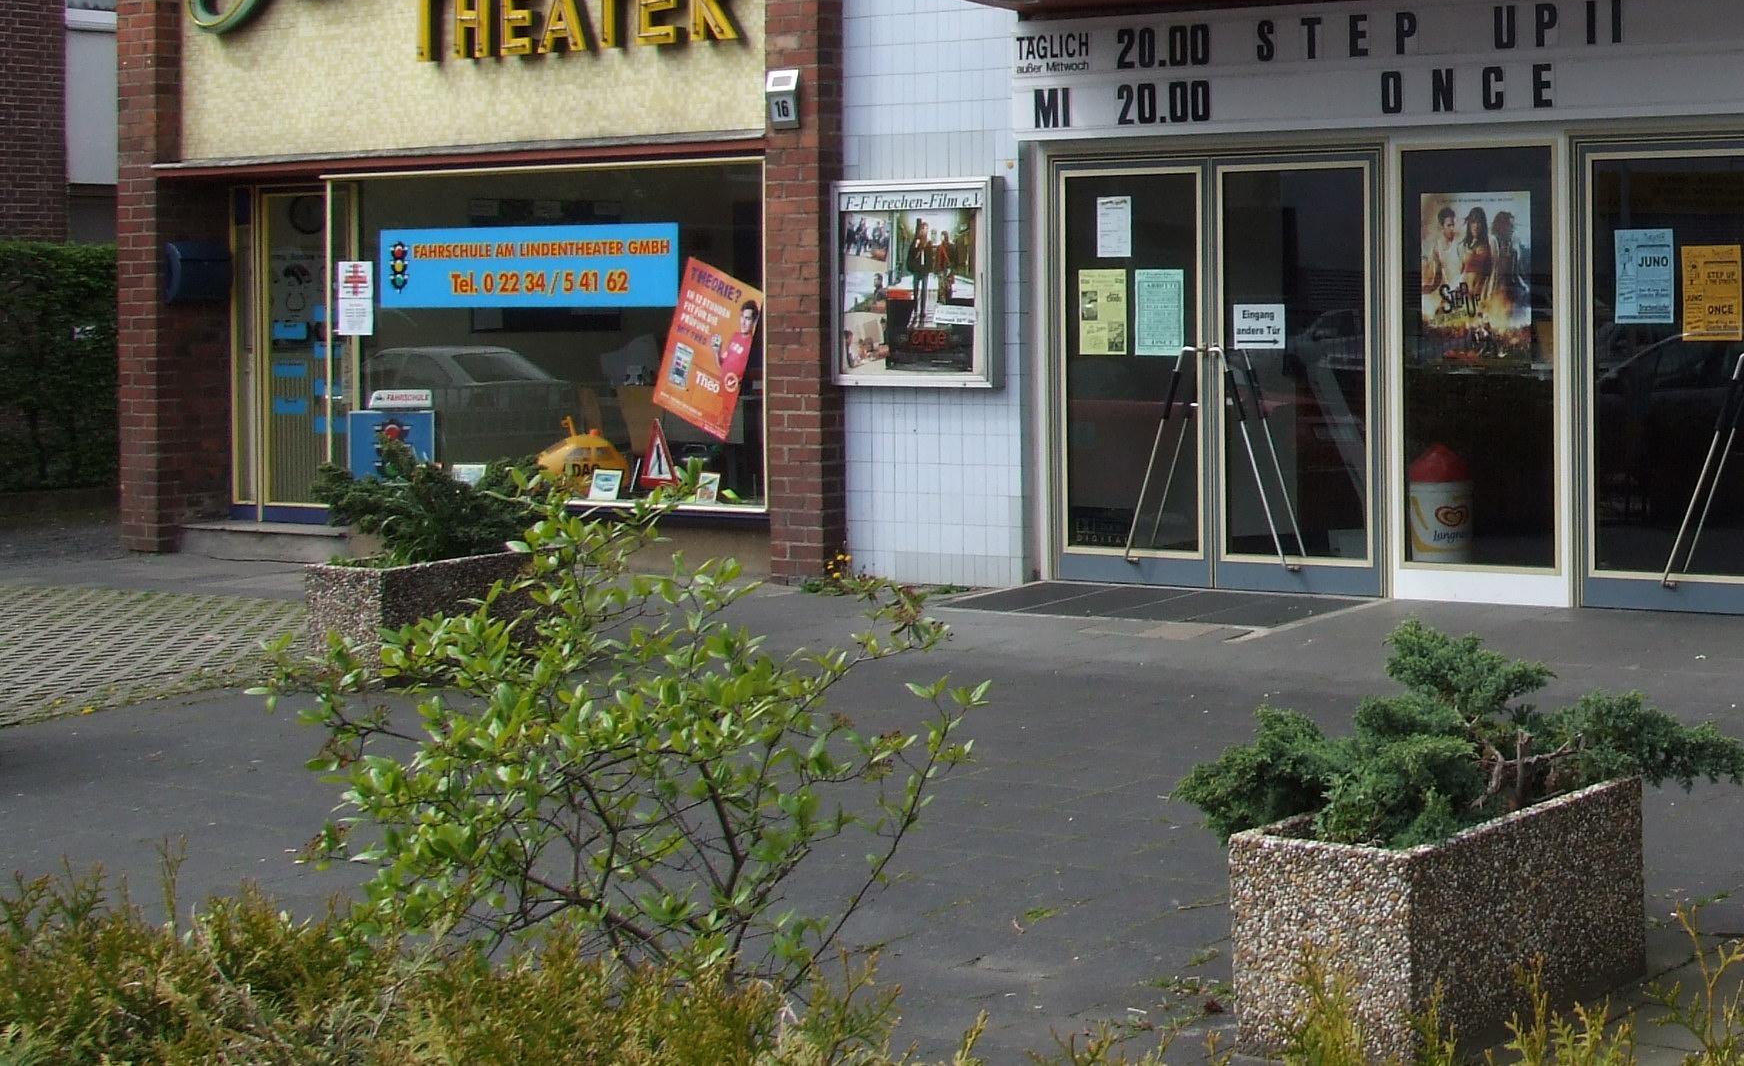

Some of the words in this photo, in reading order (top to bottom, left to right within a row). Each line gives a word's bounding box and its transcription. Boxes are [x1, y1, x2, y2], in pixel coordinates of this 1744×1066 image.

[1016, 32, 1089, 61] TÄGLICH
[1116, 23, 1211, 70] 20.00
[1256, 10, 1419, 63] STEP
[1016, 62, 1043, 74] außer
[1046, 60, 1089, 72] Mittwoch
[1034, 87, 1071, 129] MI
[1116, 79, 1211, 125] 20.00
[1380, 63, 1553, 115] ONCE
[774, 99, 789, 118] 16
[846, 195, 870, 211] F-F
[873, 192, 958, 209] Frechen-Film
[413, 242, 492, 259] FAHRSCHULE
[495, 241, 515, 258] AM
[519, 240, 625, 258] LINDENTHEATER
[628, 239, 671, 255] GMBH
[1638, 256, 1669, 268] JUNO
[451, 272, 479, 294] Tel.
[483, 272, 494, 294] 0
[499, 272, 520, 293] 22
[524, 272, 547, 293] 34
[549, 271, 560, 296] /
[563, 272, 575, 292] 5
[579, 271, 599, 292] 41
[605, 270, 630, 292] 62
[690, 266, 742, 304] THEORIE?
[1242, 309, 1275, 321] Eingang
[1707, 304, 1734, 314] ONCE
[1236, 325, 1264, 335] andere
[1266, 325, 1281, 335] Tür
[695, 370, 721, 394] Theo
[386, 393, 430, 403] FAHRSCHULE
